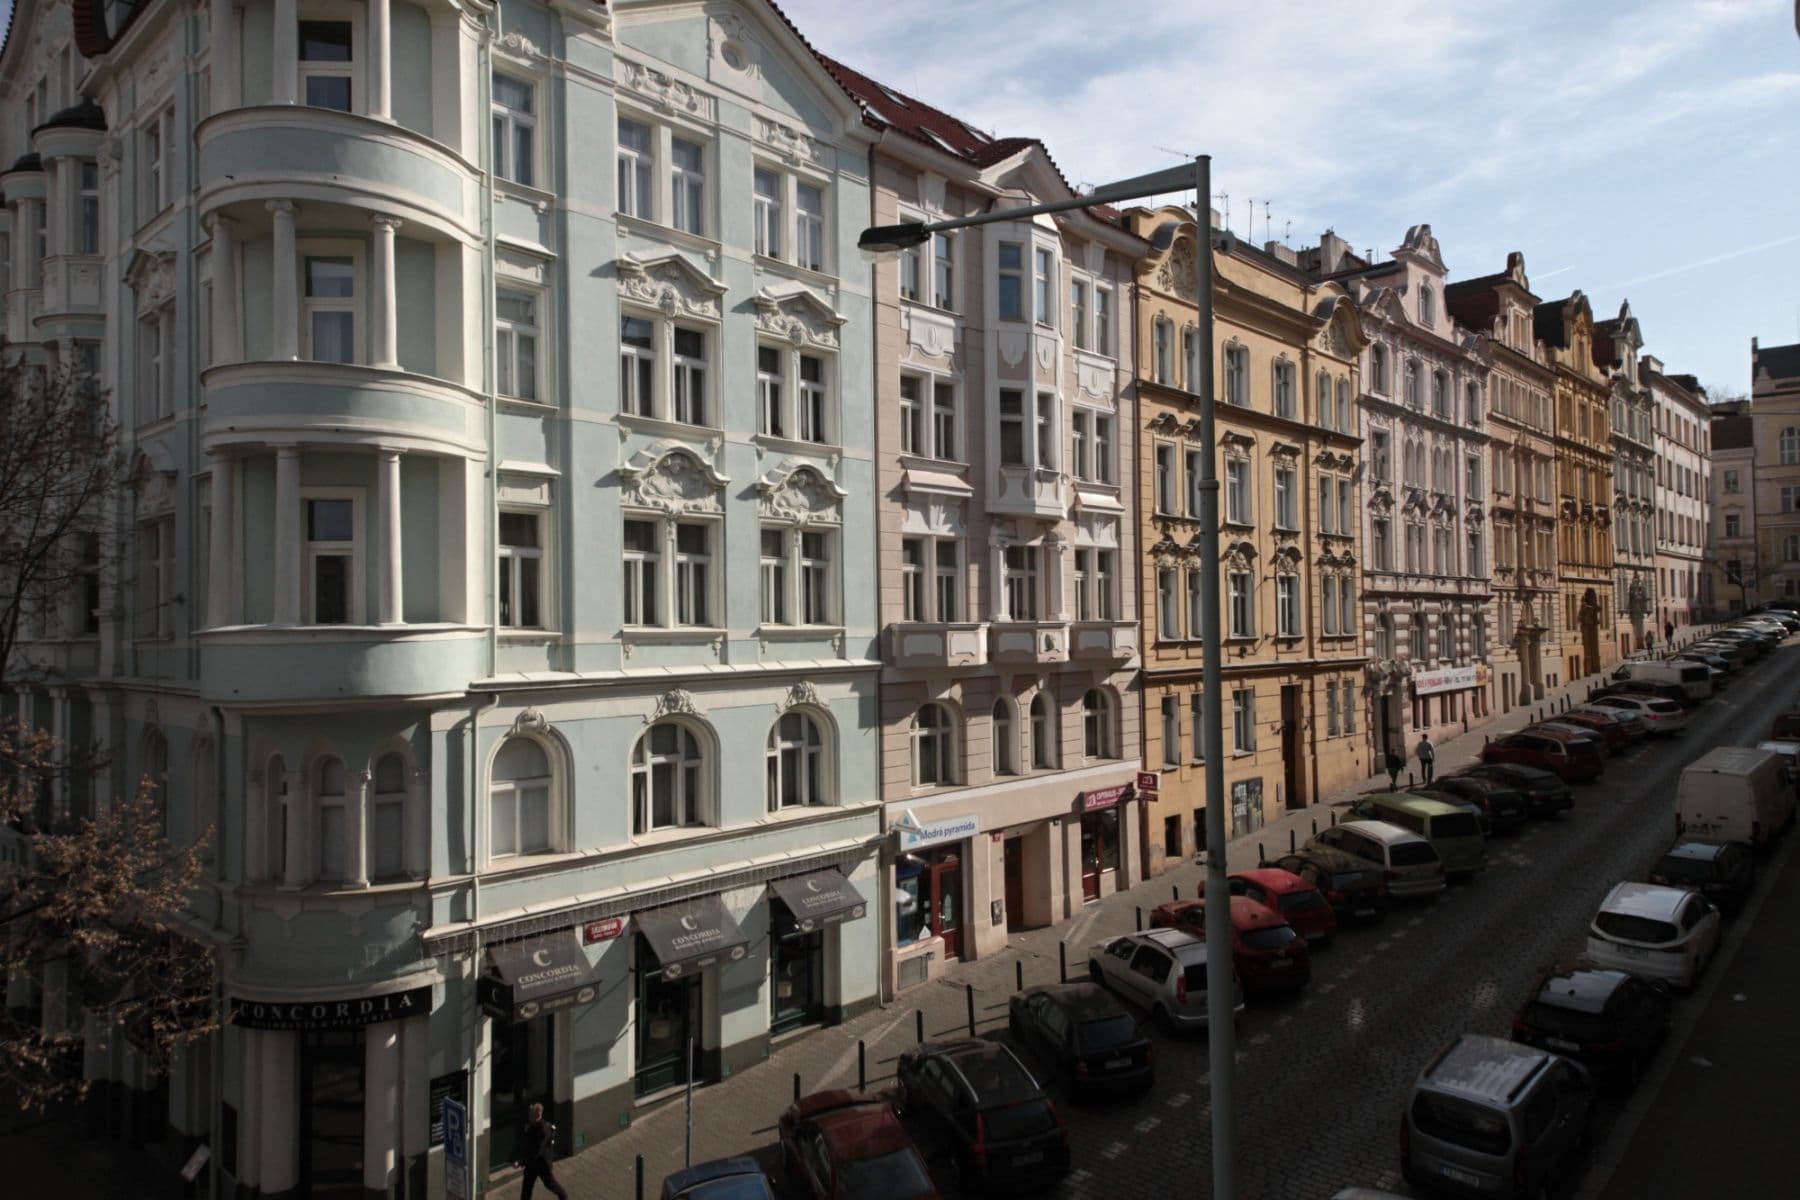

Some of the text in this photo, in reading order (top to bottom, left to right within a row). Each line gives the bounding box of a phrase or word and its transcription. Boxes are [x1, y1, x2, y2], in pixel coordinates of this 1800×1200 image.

[944, 821, 976, 838] pyramida
[801, 889, 842, 905] CONCORDIA
[671, 928, 722, 946] CONCORDIA
[518, 963, 580, 984] CONCORDIA
[238, 993, 414, 1020] CONCORDIA
[447, 1107, 460, 1142] P
